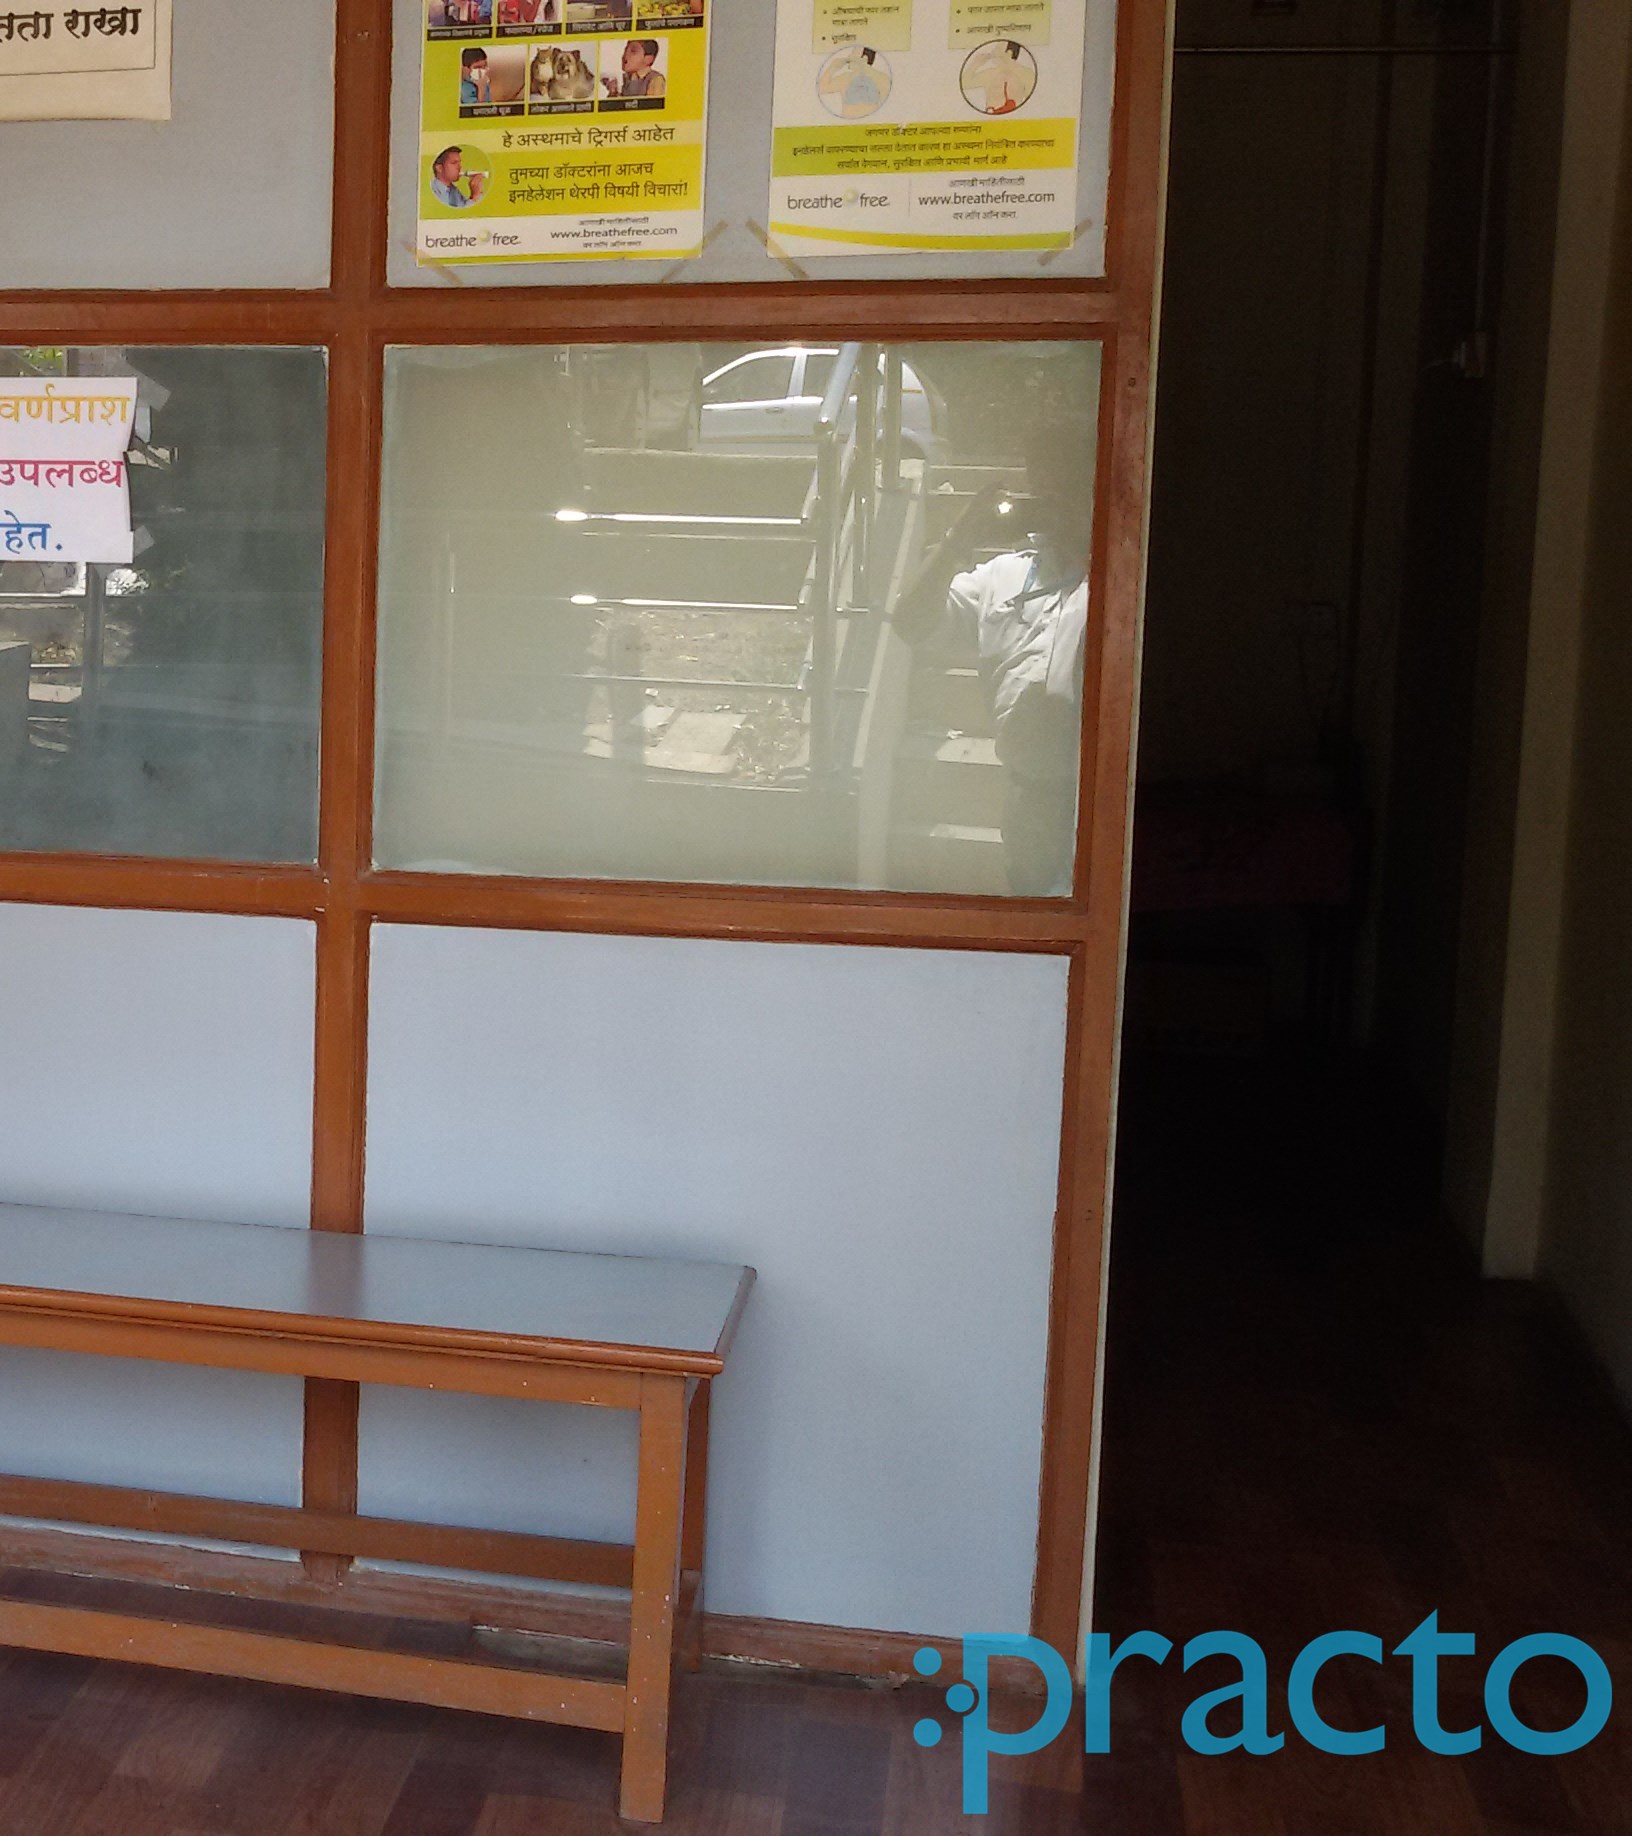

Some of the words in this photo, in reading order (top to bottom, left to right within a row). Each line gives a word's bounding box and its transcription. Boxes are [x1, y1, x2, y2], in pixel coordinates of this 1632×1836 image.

[64, 7, 142, 39] राखा
[502, 130, 513, 148] हे
[517, 128, 583, 147] अस्थमाचे
[588, 126, 628, 147] ट्रिगर्स
[632, 124, 675, 142] आहेत
[509, 167, 549, 184] तुमच्या
[554, 161, 611, 179] डॉक्टरांना
[615, 162, 654, 176] आजच
[508, 184, 565, 203] इनहेलेशन
[569, 183, 600, 200] थेरपी
[604, 181, 640, 198] विषयी
[918, 191, 1055, 206] www.breathefree.com
[787, 195, 842, 209] breathe
[425, 234, 477, 248] breathe
[550, 226, 678, 240] www.breathefree.com
